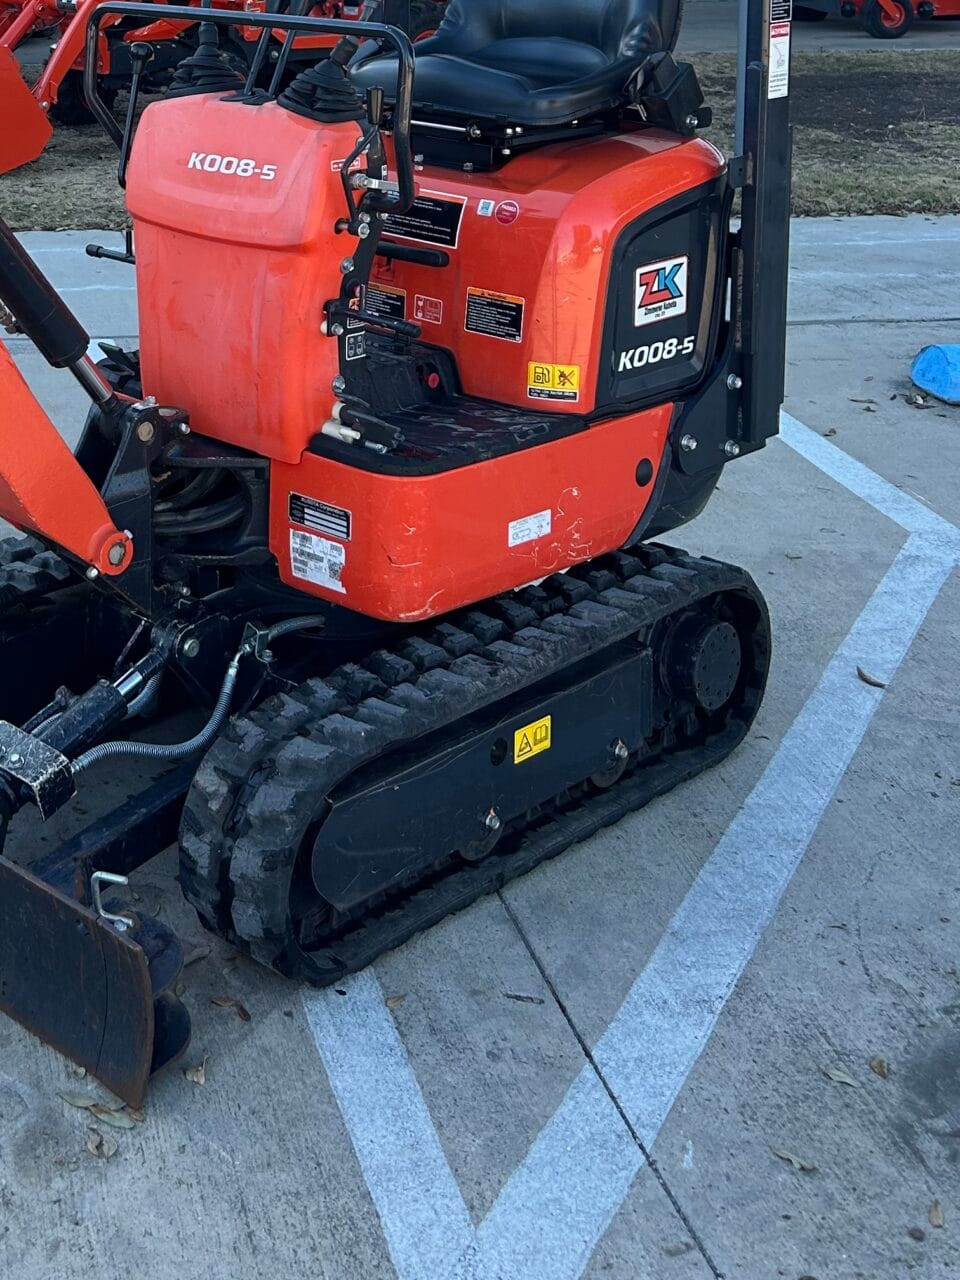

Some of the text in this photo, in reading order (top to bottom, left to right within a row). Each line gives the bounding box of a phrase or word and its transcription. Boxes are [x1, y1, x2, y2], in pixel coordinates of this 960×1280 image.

[187, 152, 277, 180] K008-5
[638, 263, 685, 309] ZK
[618, 336, 695, 372] K008-5
